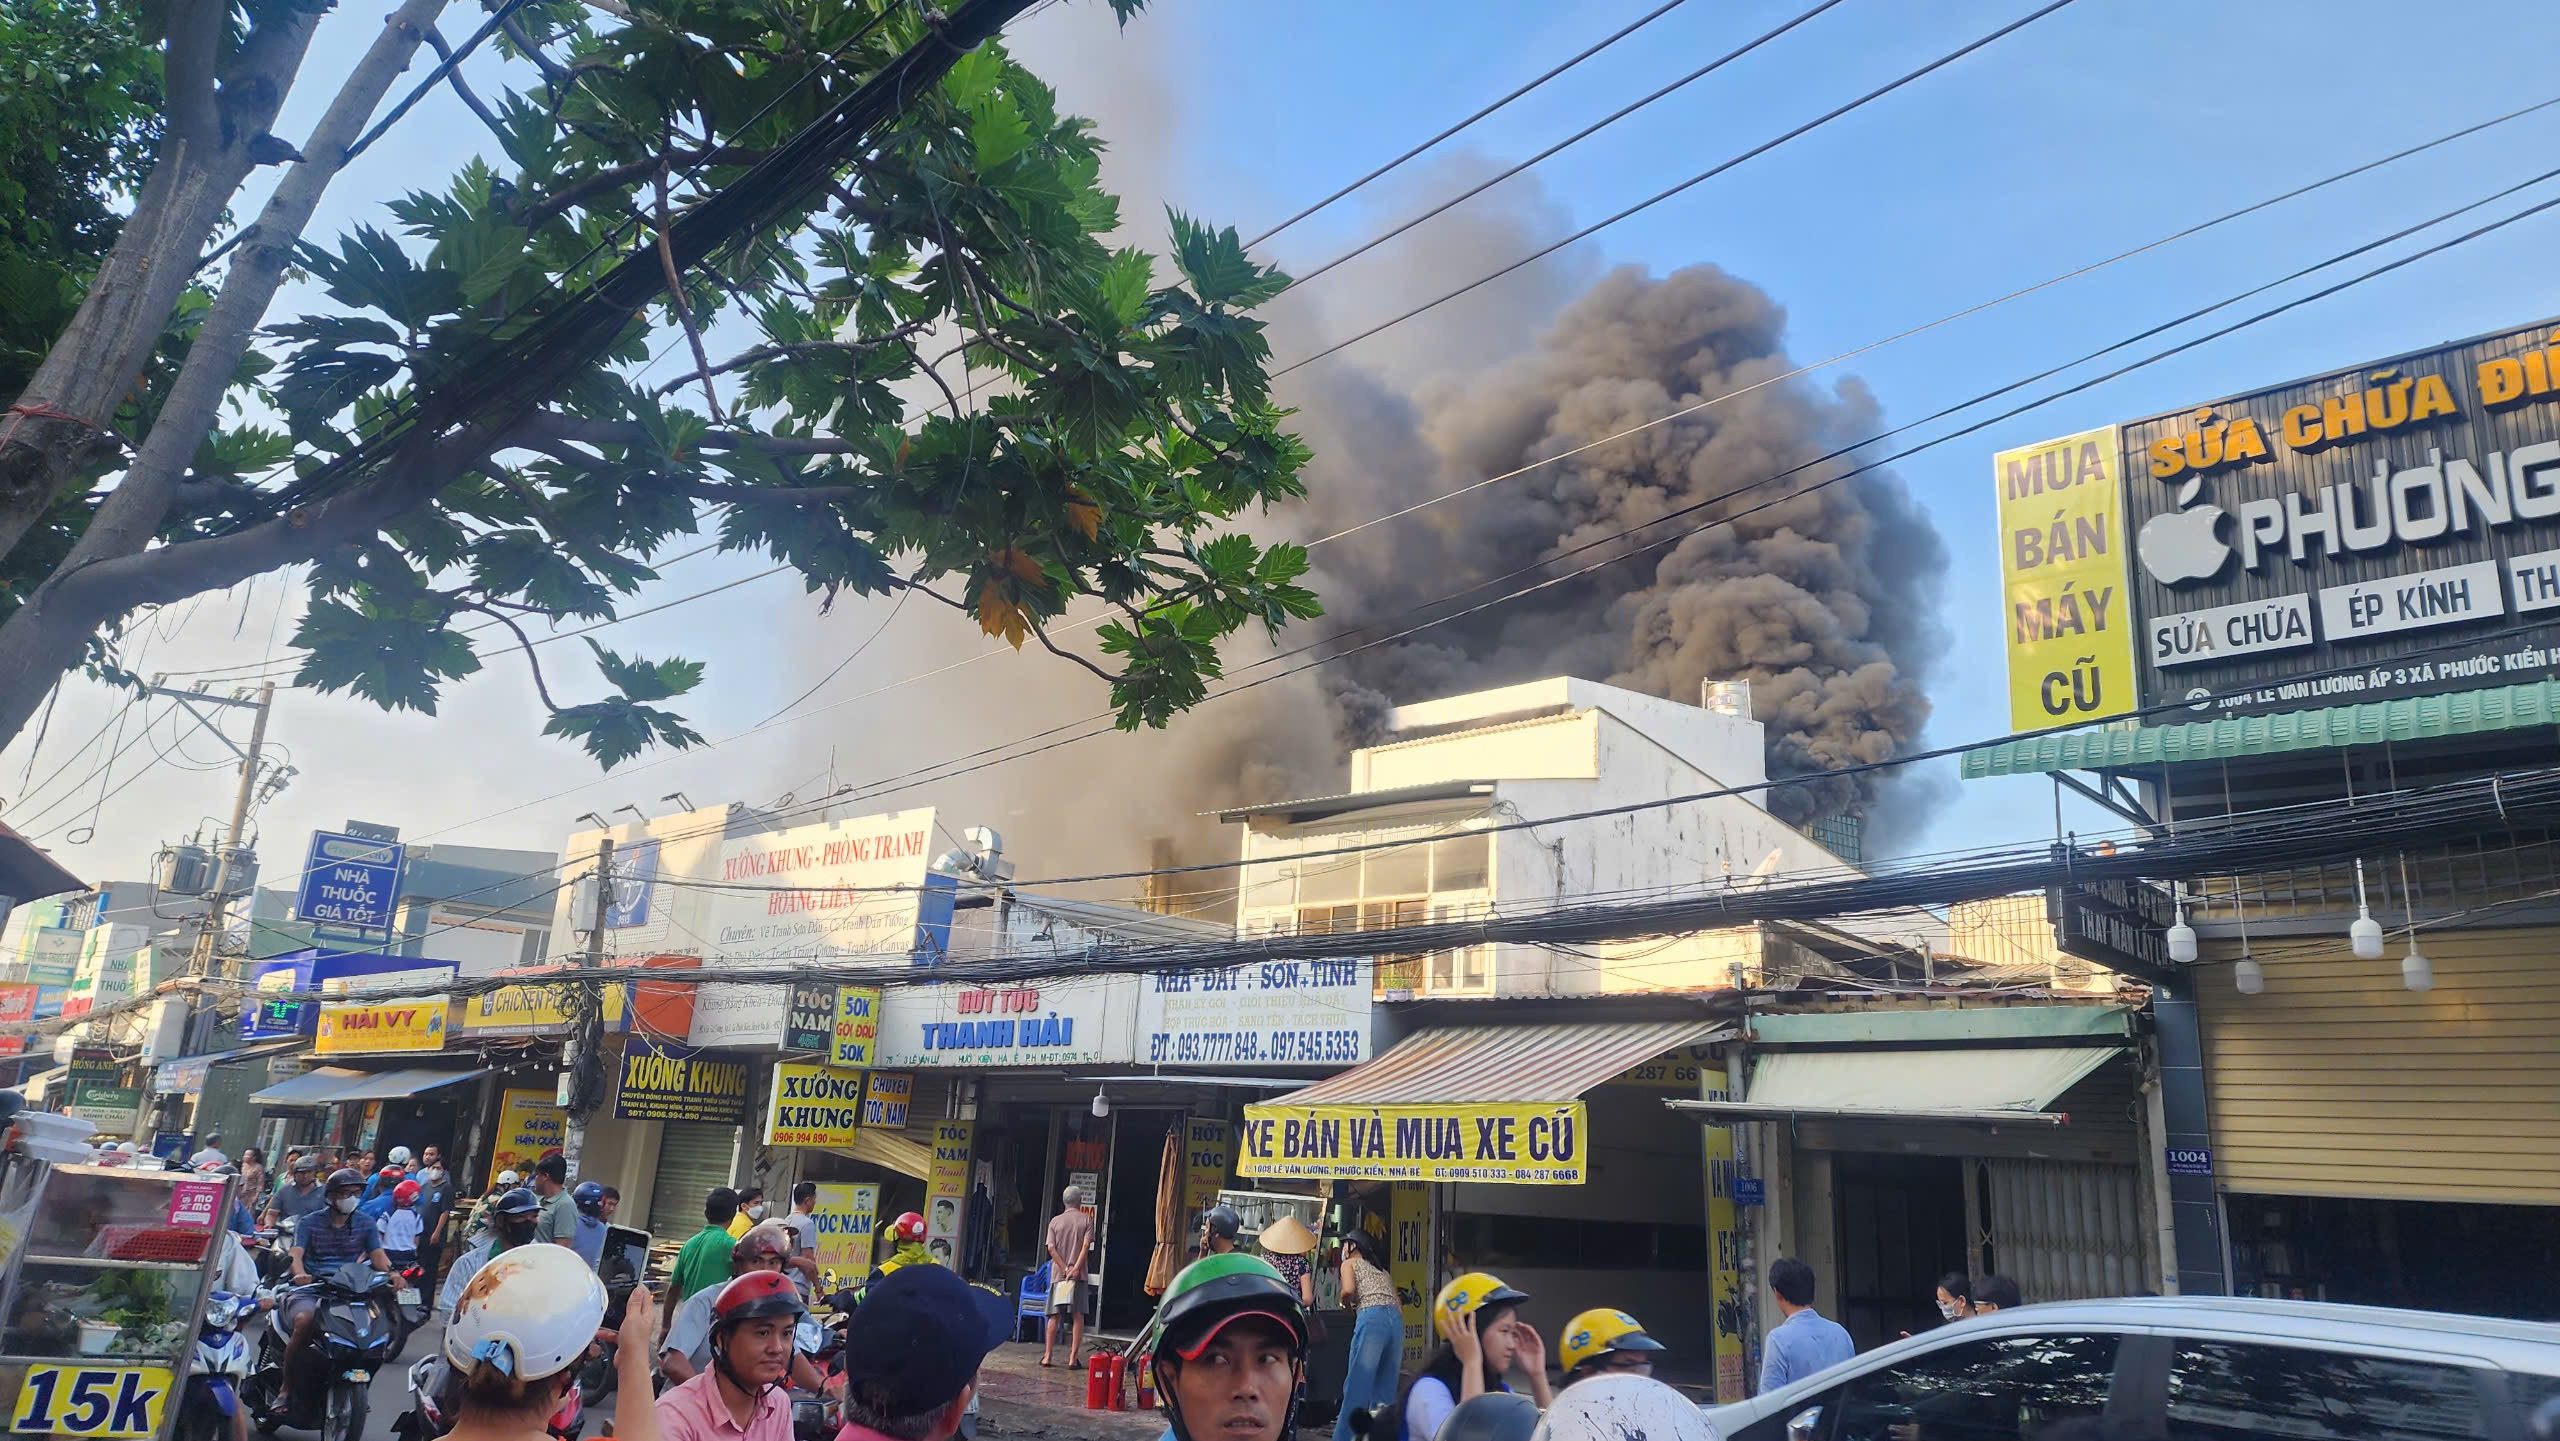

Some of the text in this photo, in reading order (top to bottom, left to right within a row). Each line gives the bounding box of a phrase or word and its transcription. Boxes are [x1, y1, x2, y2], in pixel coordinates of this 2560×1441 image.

[2148, 406, 2267, 478] SỬA
[2282, 368, 2457, 448] CHỮA
[2006, 441, 2106, 501] MUA
[2014, 509, 2108, 571] BÁN
[2015, 580, 2113, 645] MÁY
[2348, 577, 2472, 629] ÉP KÍNH
[2157, 603, 2307, 659] SỬA CHỮA
[2311, 675, 2366, 696] LƯƠNG
[2368, 667, 2392, 689] ẤP
[2395, 668, 2407, 685] 3
[2410, 662, 2435, 684] XÃ
[2439, 654, 2501, 679] PHƯỚC
[2504, 644, 2547, 671] KIỂN
[2040, 654, 2102, 716] CŨ
[722, 831, 925, 882] XƯỞNG KHUNG PHÒNG TRANH
[335, 867, 370, 885] NHÀ
[320, 885, 377, 905] THUỐC
[767, 876, 857, 916] HOÀNG LIÊN
[314, 903, 376, 924] GIÁ TỐT
[720, 926, 756, 943] Chuyên:
[759, 924, 770, 938] Vẽ
[771, 923, 792, 938] Tranh
[793, 921, 807, 936] Sơn
[2080, 905, 2108, 946] THAY
[880, 940, 911, 952] Canvas
[495, 990, 543, 1013] CHICKEN
[797, 987, 832, 1011] TÓC
[845, 996, 871, 1018] 50K
[342, 1008, 417, 1031] HẢI VY
[791, 1011, 832, 1033] NAM
[921, 1011, 1073, 1050] THANH HẢI
[838, 1043, 865, 1062] 50K
[1177, 1030, 1359, 1062] 093.7777.848 097.545.5353
[625, 1044, 748, 1097] XƯỞNG KHUNG
[1634, 1066, 1667, 1080] 287
[783, 1068, 858, 1101] XƯỞNG
[649, 1102, 669, 1110] KHUNG
[684, 1104, 703, 1112] KHUNG
[662, 1094, 682, 1102] KHUNG
[627, 1109, 645, 1118] SĐT:
[777, 1106, 854, 1129] KHUNG
[864, 1095, 907, 1126] TÓC NAM
[774, 1132, 794, 1144] 0906
[795, 1133, 811, 1144] 994
[813, 1133, 828, 1145] 890
[938, 1124, 968, 1141] TÓC
[1191, 1122, 1225, 1143] HỚT
[1245, 1108, 1574, 1162] XE BÁN VÀ MUA XE CŨ
[935, 1147, 968, 1162] NAM
[1191, 1149, 1224, 1168] TÓC
[2169, 1151, 2208, 1163] 1004
[935, 1166, 966, 1177] Thanh
[1253, 1165, 1272, 1174] 1008
[1273, 1163, 1283, 1174] LÊ
[1285, 1164, 1301, 1174] VĂN
[1333, 1164, 1362, 1176] PHƯỚC
[1364, 1163, 1387, 1177] KIỂN,
[1389, 1165, 1408, 1177] NHÀ
[1435, 1167, 1448, 1178] ĐT:
[1449, 1168, 1470, 1179] 0909
[1472, 1168, 1488, 1179] 510
[1490, 1169, 1506, 1179] 333
[1515, 1169, 1531, 1179] 084
[1534, 1169, 1550, 1180] 287
[1552, 1170, 1579, 1181] 6668
[810, 1207, 872, 1234] TÓC NAM
[816, 1241, 841, 1265] hanh
[1399, 1221, 1408, 1263] XE
[1717, 1230, 1730, 1272] XE
